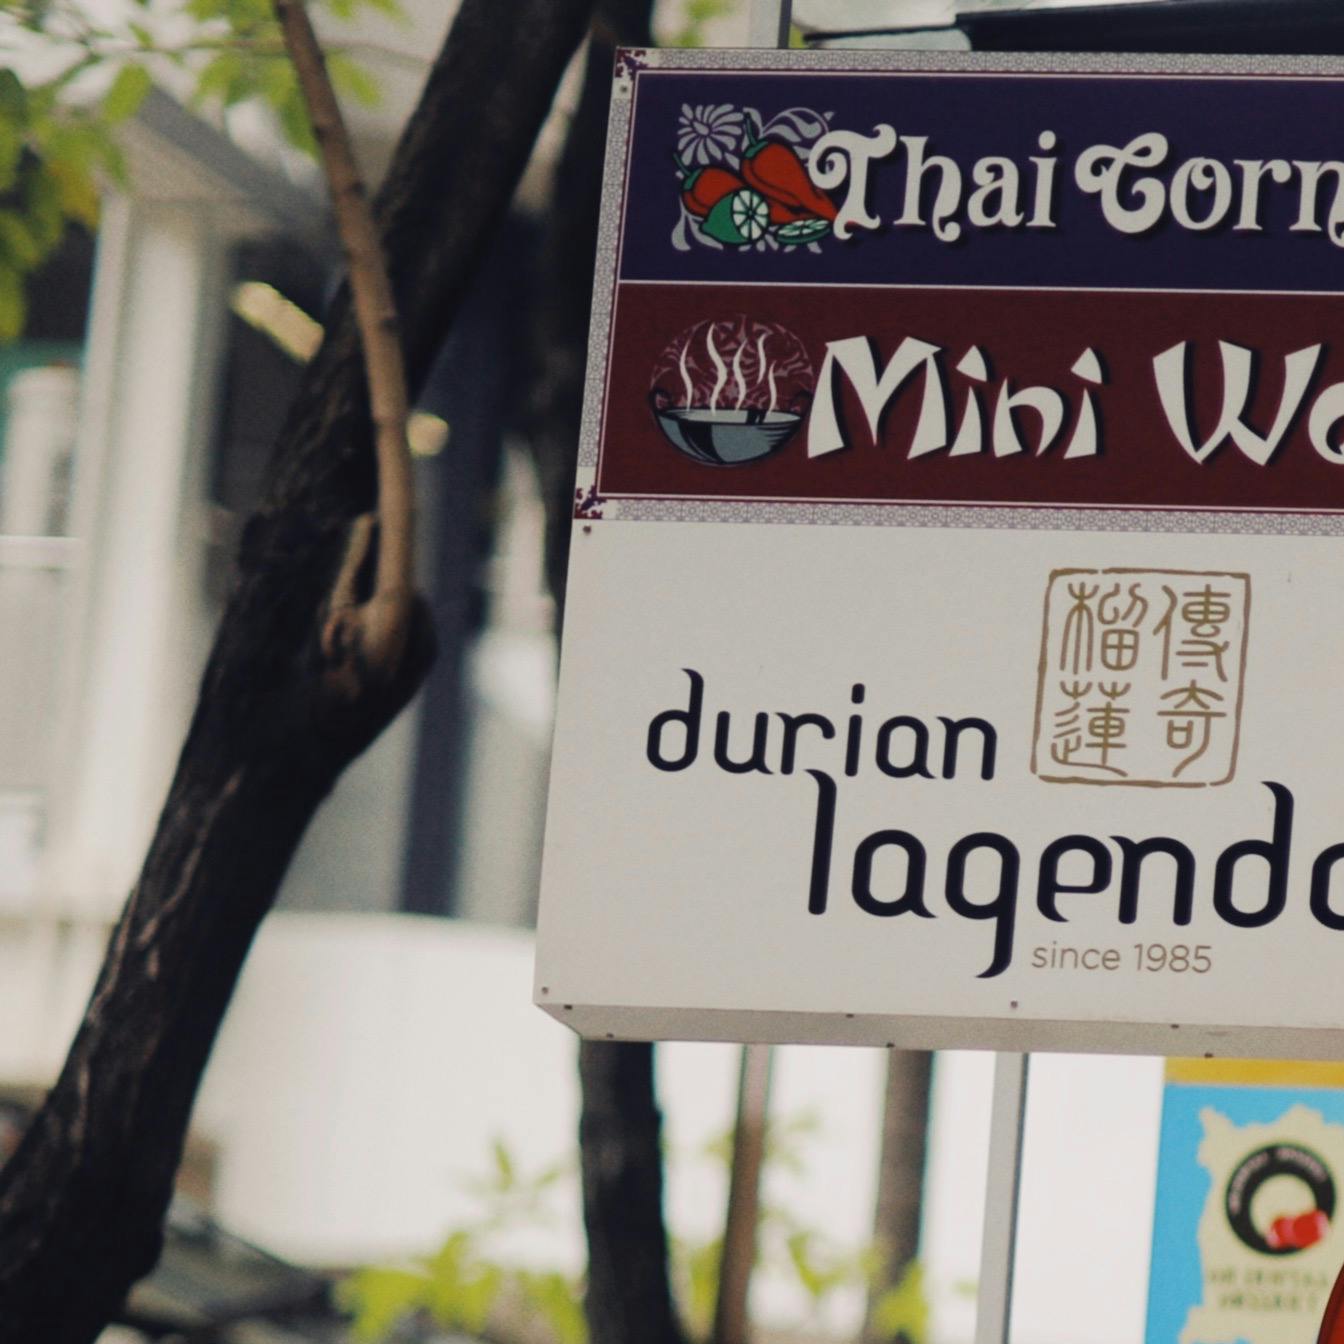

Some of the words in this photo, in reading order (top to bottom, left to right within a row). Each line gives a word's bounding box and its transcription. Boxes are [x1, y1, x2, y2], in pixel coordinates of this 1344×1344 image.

[807, 122, 1057, 243] Thai
[807, 335, 1110, 460] Mini
[646, 667, 999, 782] durian
[1031, 942, 1121, 974] since
[1133, 942, 1213, 976] 1985
